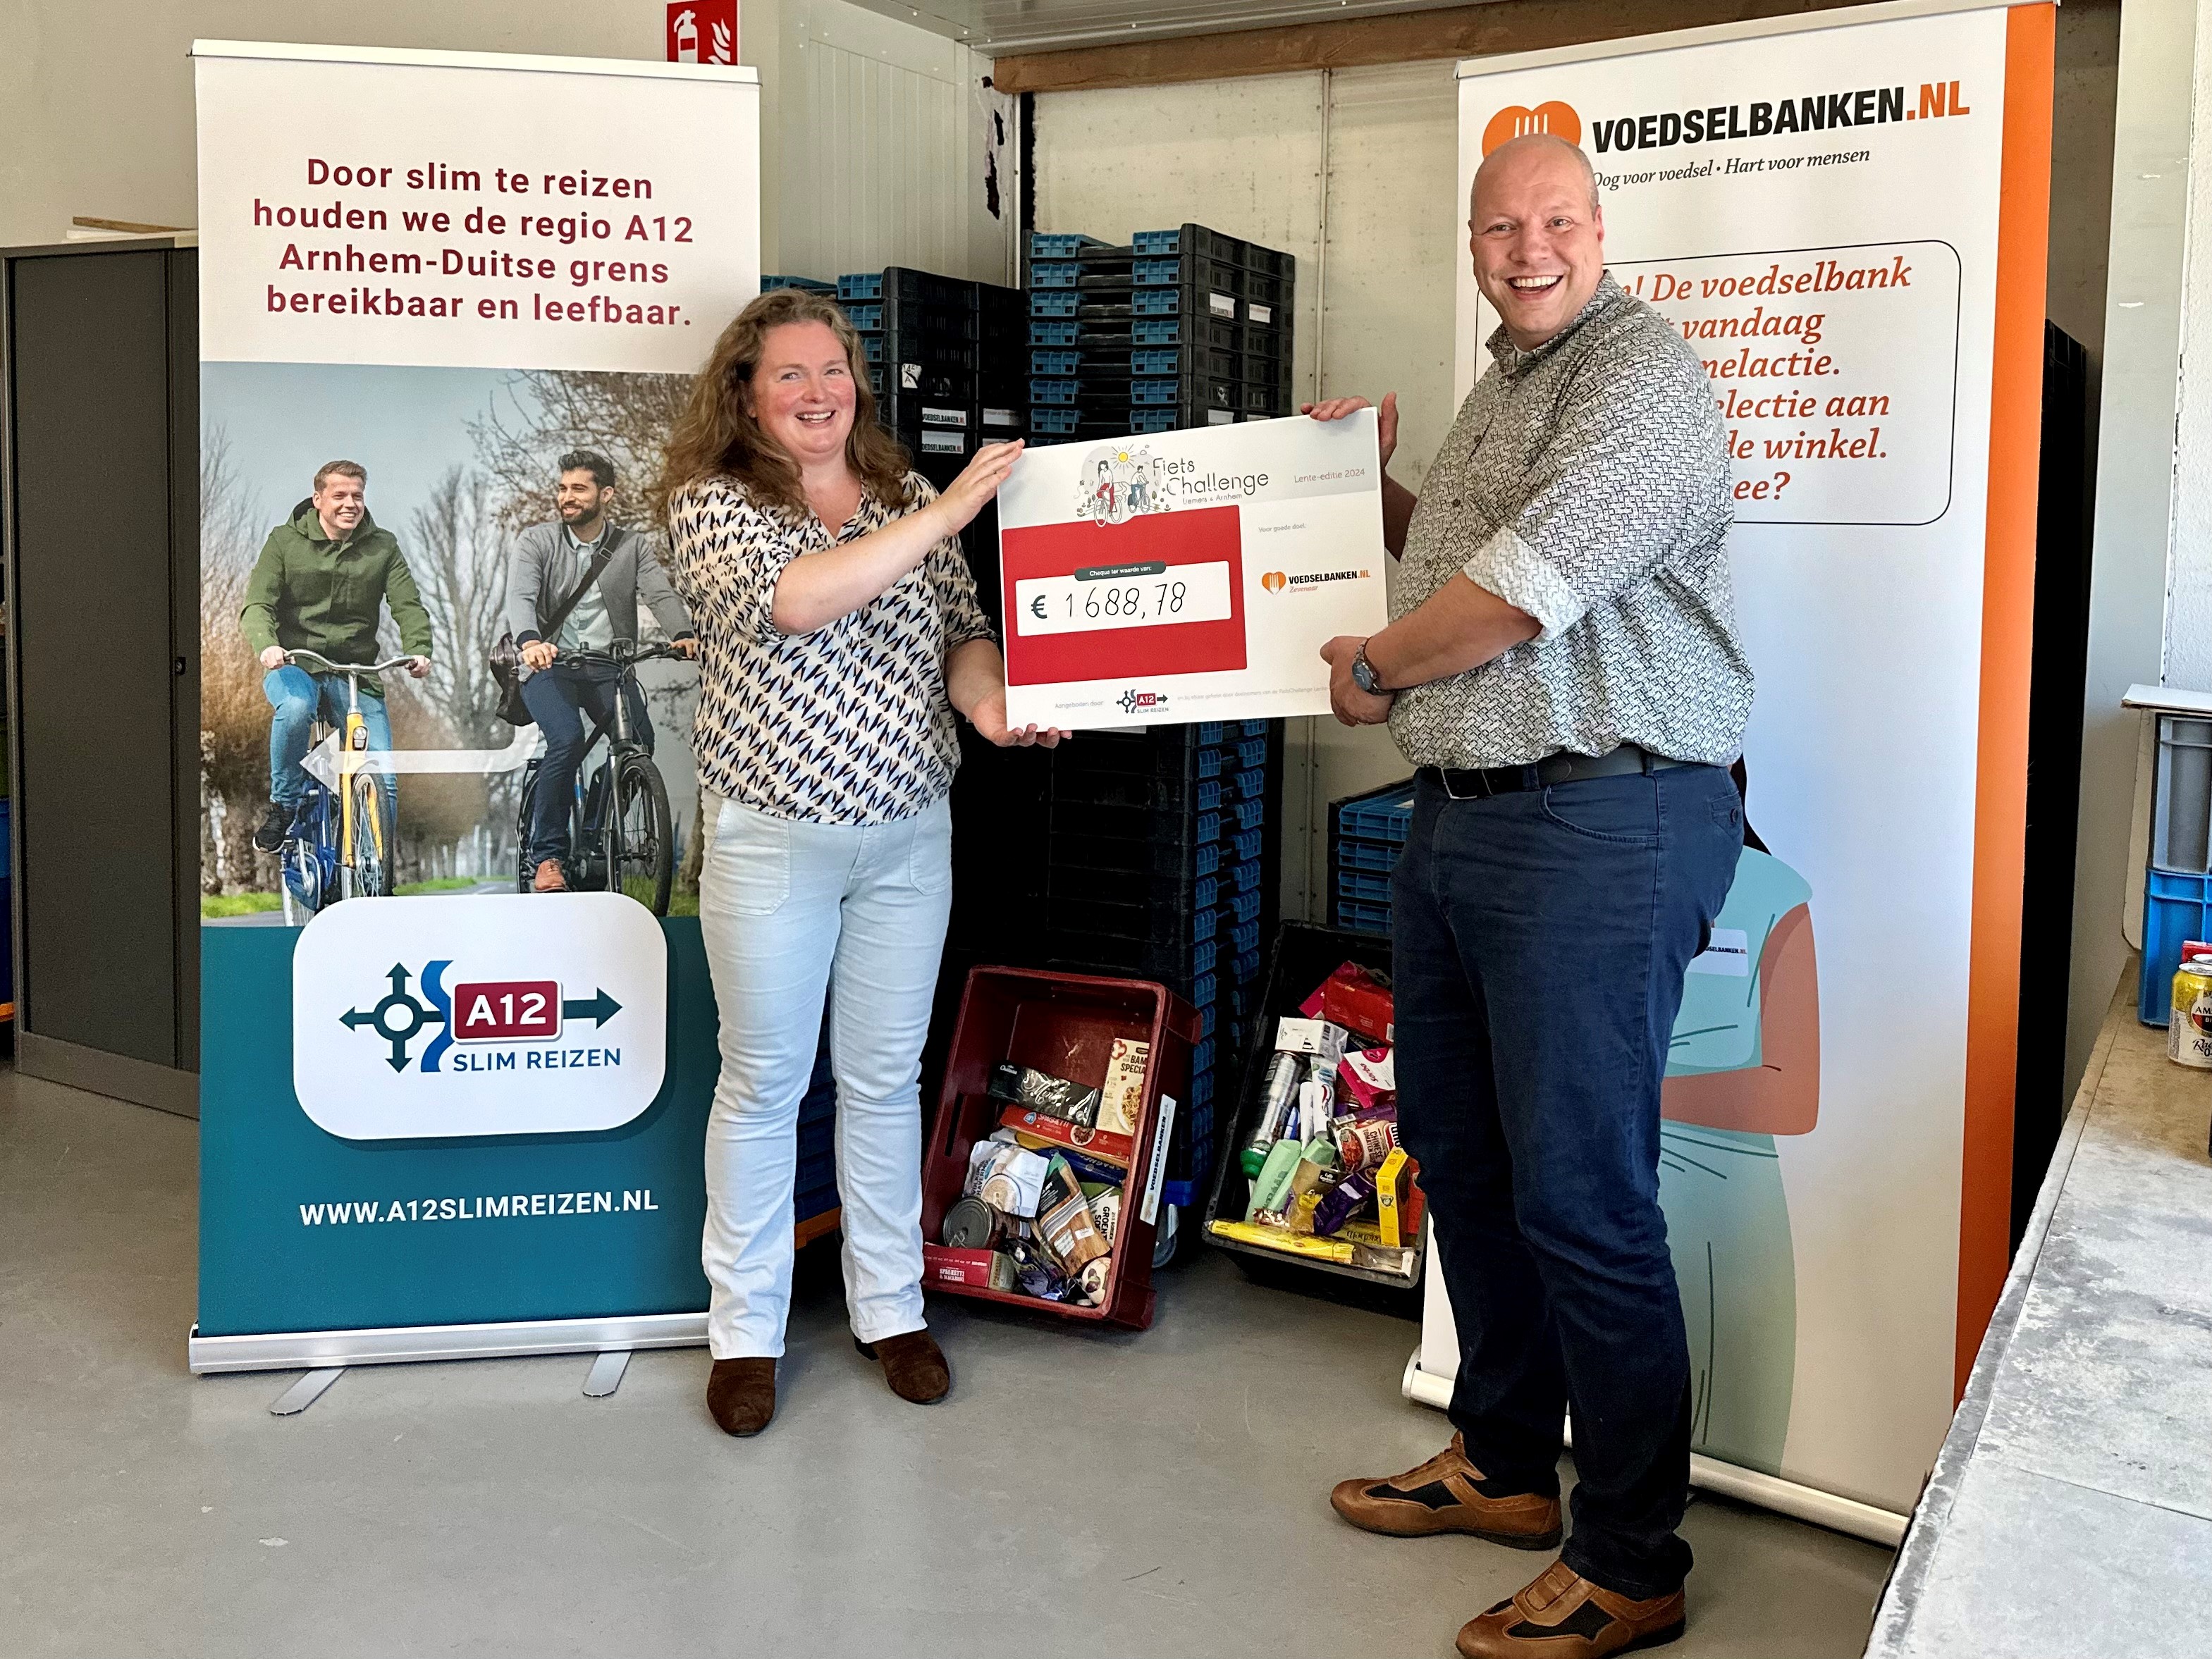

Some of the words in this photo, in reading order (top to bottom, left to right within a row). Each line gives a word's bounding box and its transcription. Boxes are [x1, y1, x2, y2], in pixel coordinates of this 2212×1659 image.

[1592, 80, 1970, 154] VOEDSELBANKEN.NL
[308, 158, 393, 188] Door
[406, 162, 481, 192] slim
[496, 168, 529, 194] te
[543, 169, 653, 199] reizen
[1623, 173, 1656, 185] voor
[1659, 159, 1713, 181] voedsel
[1724, 156, 1764, 175] Hart
[1768, 157, 1804, 171] voor
[1807, 149, 1870, 167] mensen
[254, 199, 387, 230] houden
[403, 210, 450, 233] we
[465, 206, 505, 235] de
[521, 211, 611, 244] regio
[625, 215, 694, 243] A12
[278, 243, 555, 279] Arnhem-Duitse
[570, 260, 669, 287] grens
[1651, 273, 1692, 302] De
[1701, 255, 1911, 299] voedselbank
[267, 285, 463, 318] bereikbaar
[477, 299, 518, 320] en
[534, 293, 691, 326] leefbaar.
[1682, 307, 1826, 345] vandaag
[1826, 393, 1890, 417] aan
[1764, 428, 1887, 459] winkel.
[1153, 457, 1195, 476] Fiets
[1294, 471, 1342, 483] Lente-editie
[1345, 469, 1365, 479] 2024
[1167, 472, 1268, 495] Challenge
[1733, 471, 1791, 500] ee?
[1289, 569, 1370, 584] VOEDSELBANKEN.NL
[1138, 694, 1154, 705] A12
[465, 993, 547, 1026] A12
[453, 1051, 516, 1072] SLIM
[527, 1048, 621, 1069] REIZEN
[300, 1190, 658, 1226] WWW.A12SLIMREIZEN.NL
